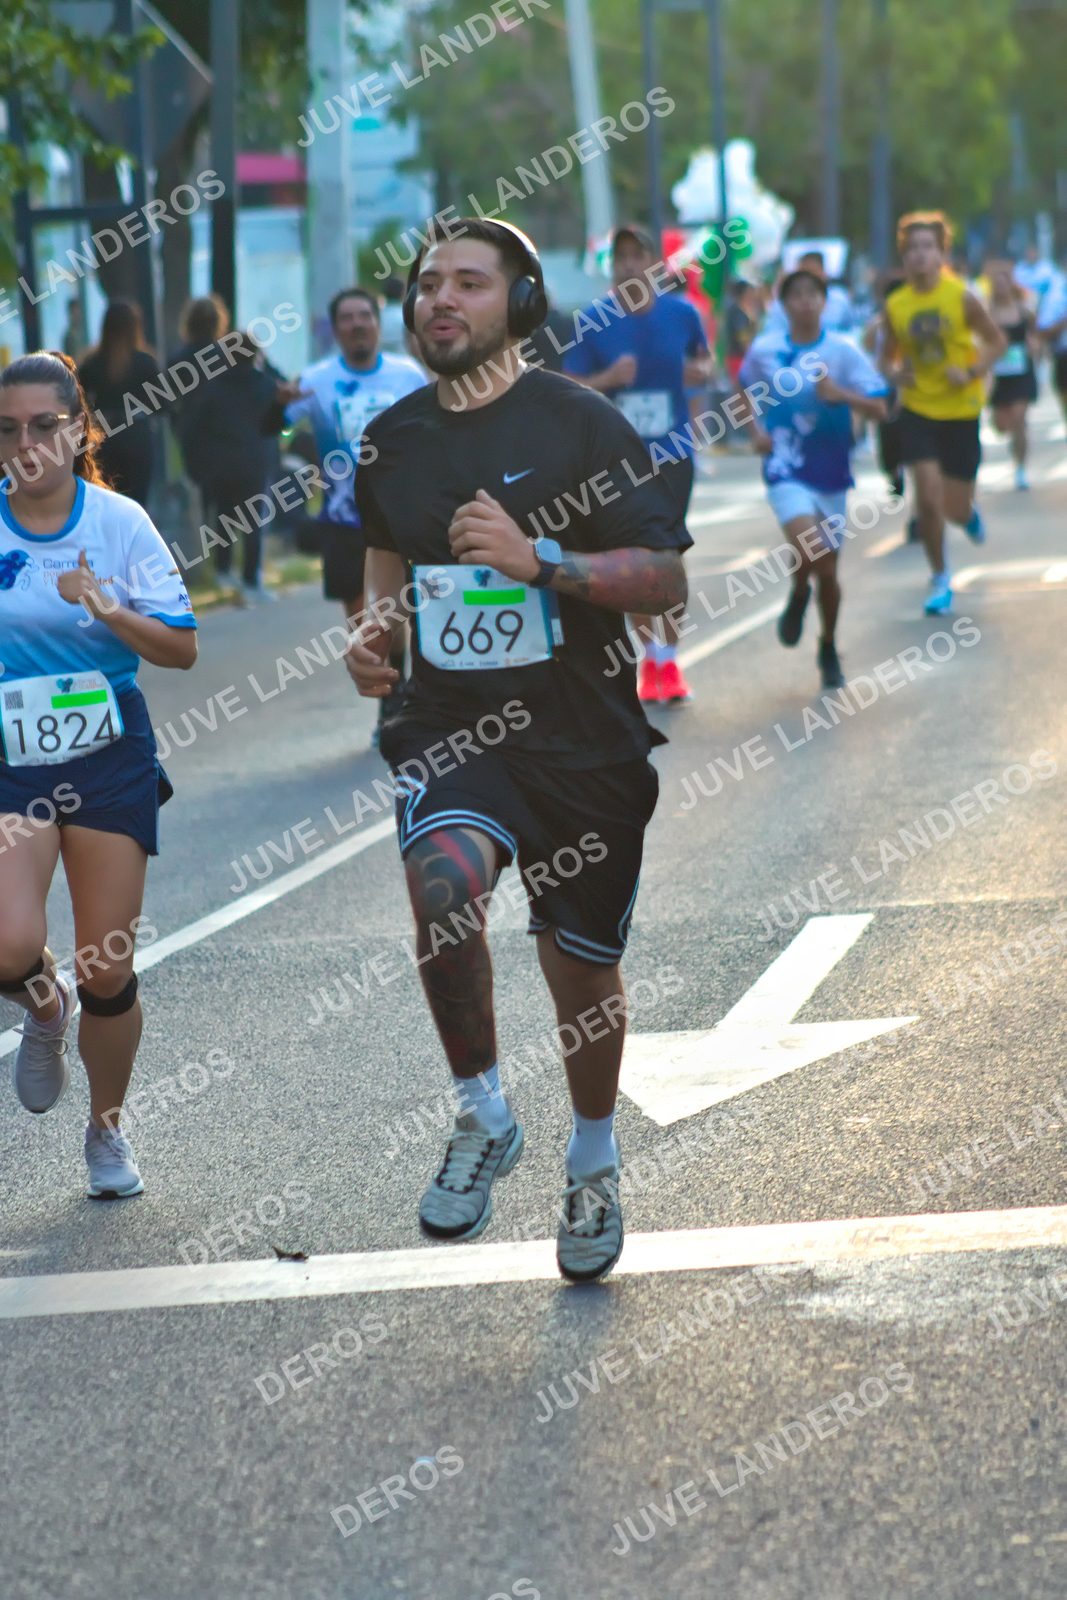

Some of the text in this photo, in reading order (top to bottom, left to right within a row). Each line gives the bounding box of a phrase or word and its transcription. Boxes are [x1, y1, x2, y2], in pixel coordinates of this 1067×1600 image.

[43, 558, 94, 569] Carrea
[439, 610, 523, 655] 669
[12, 707, 118, 755] 1824
